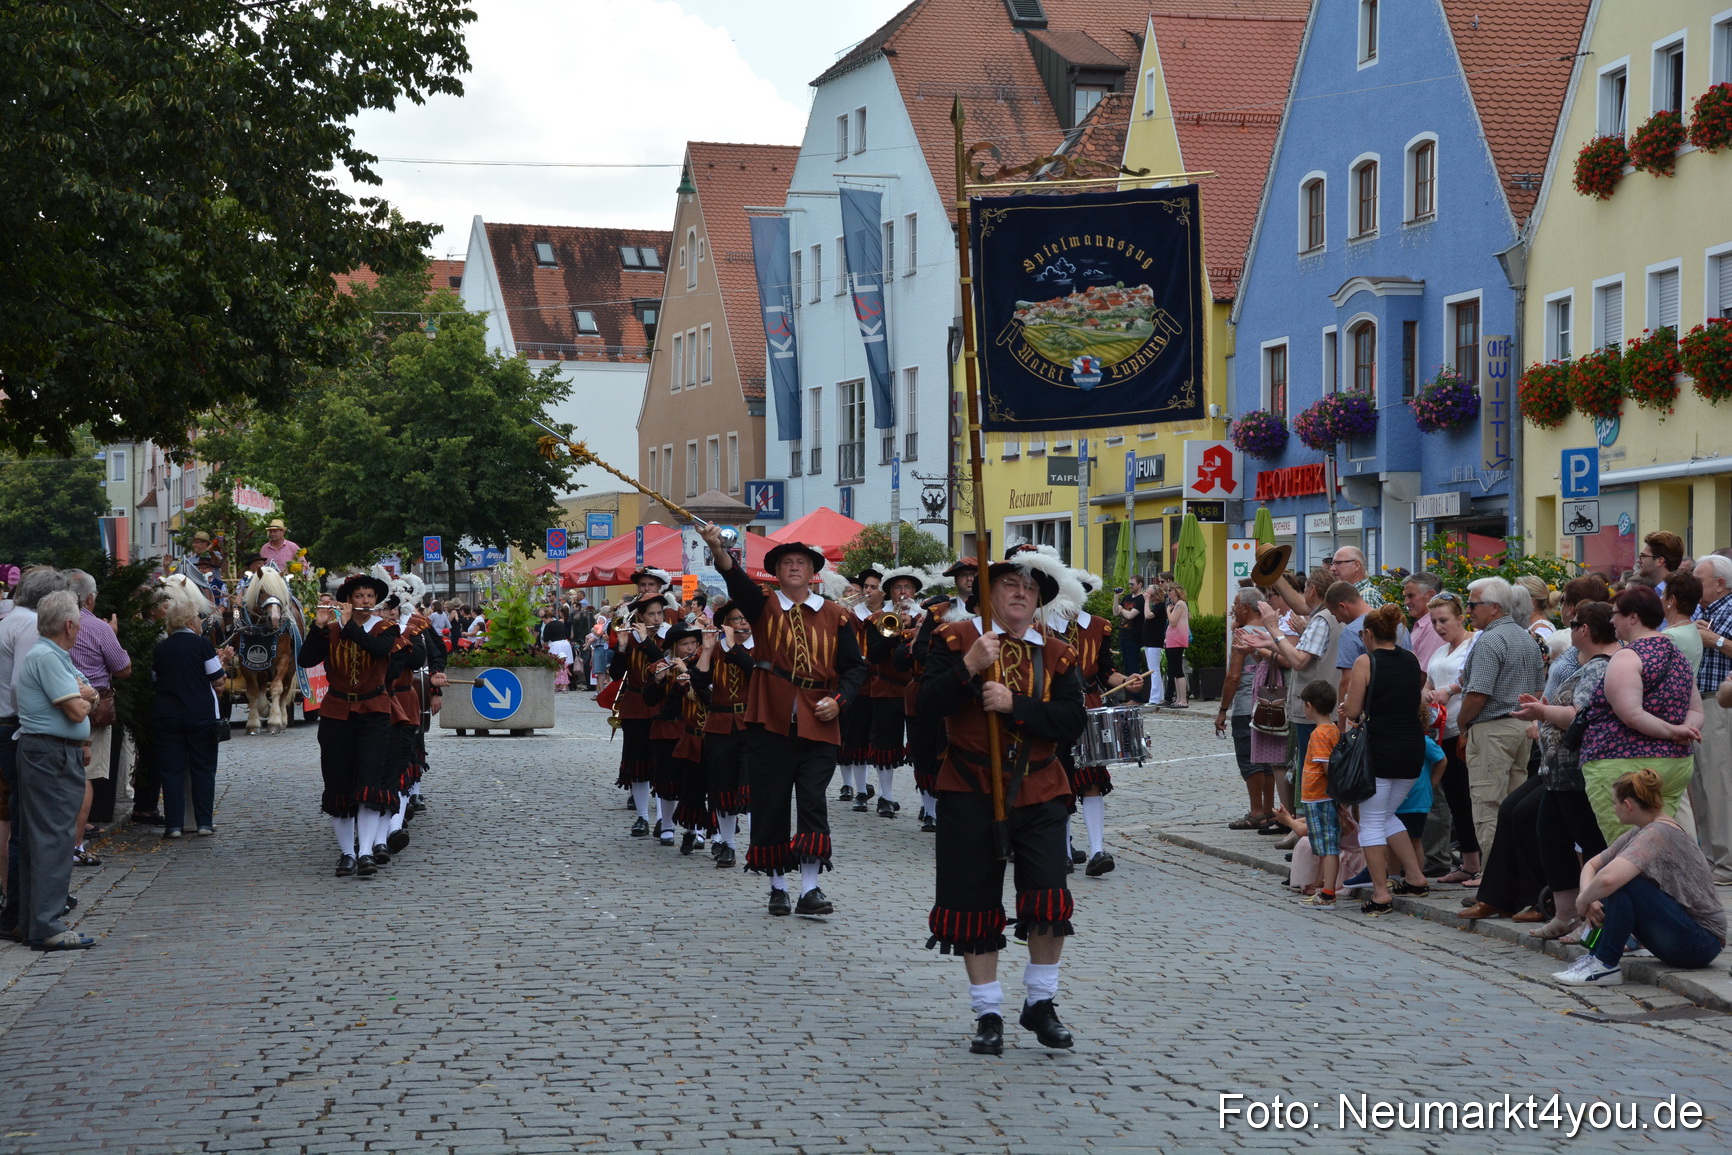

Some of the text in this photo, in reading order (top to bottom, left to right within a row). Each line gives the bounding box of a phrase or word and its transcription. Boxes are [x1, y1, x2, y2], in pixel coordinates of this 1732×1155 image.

[1023, 234, 1155, 273] Spielmannszug
[1016, 334, 1168, 382] Markt Lupburg
[1487, 337, 1510, 357] CAFÉ
[1488, 361, 1508, 457] WITTL
[1127, 457, 1134, 487] P
[1254, 460, 1341, 501] APOTHEK
[1570, 454, 1591, 492] P
[1009, 488, 1053, 509] Restaurant
[1574, 504, 1586, 512] nur
[549, 549, 565, 557] TAXI
[637, 530, 643, 551] P
